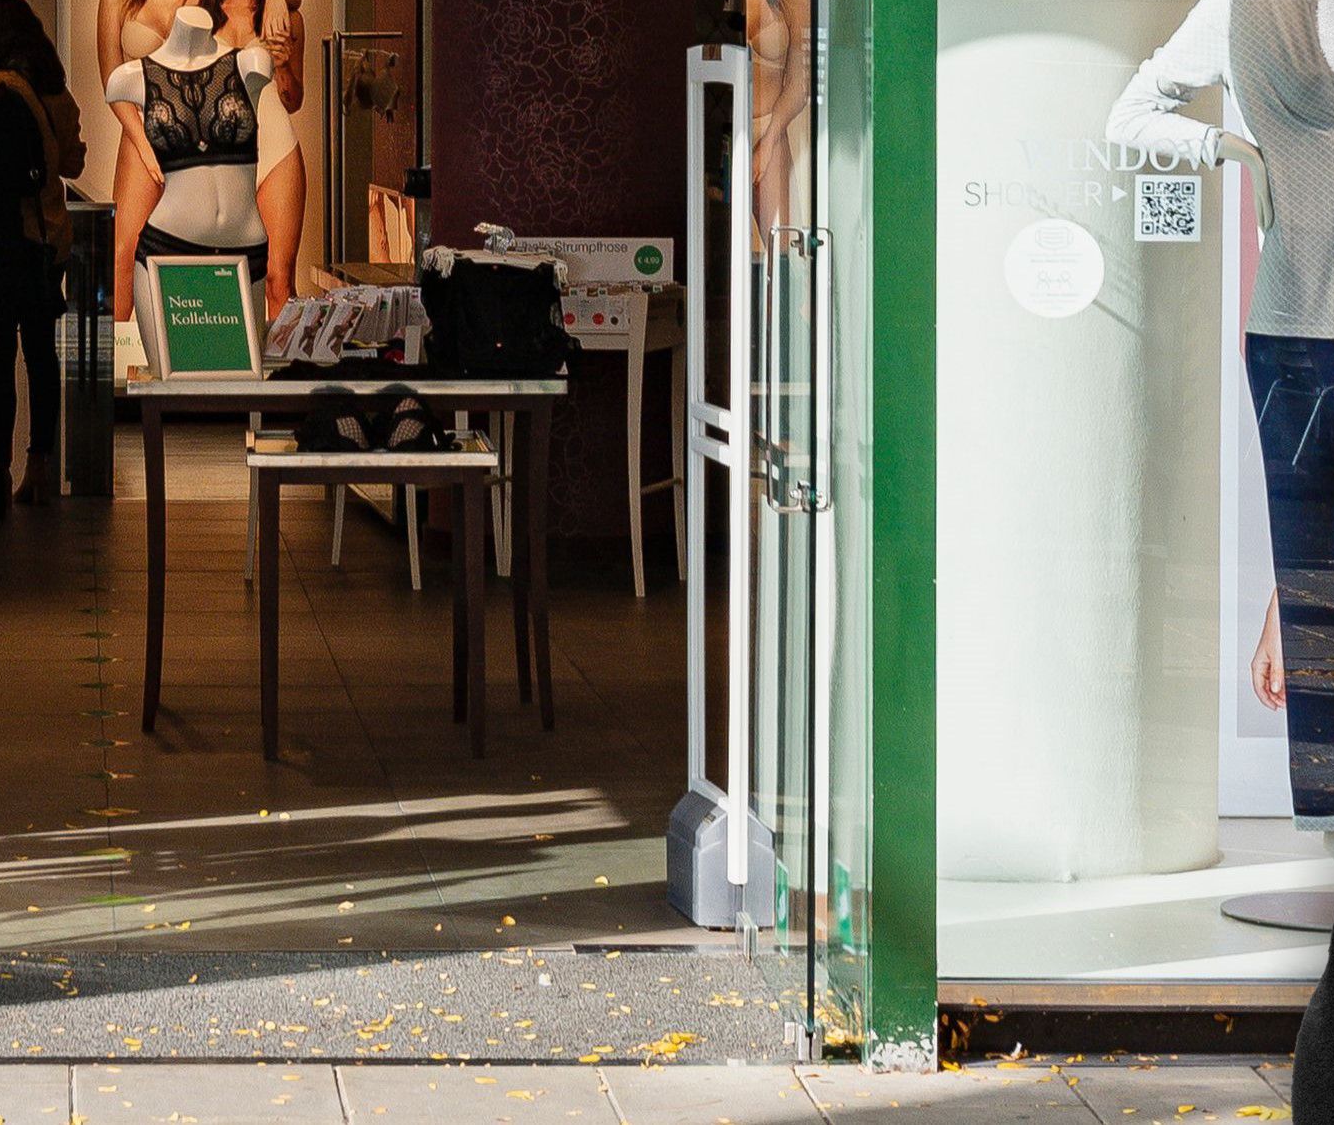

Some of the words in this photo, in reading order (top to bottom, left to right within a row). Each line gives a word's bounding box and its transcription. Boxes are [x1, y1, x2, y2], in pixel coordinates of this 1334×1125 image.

[554, 240, 628, 255] Strumpfhose
[168, 295, 204, 309] Neue
[170, 312, 239, 326] Kollektion
